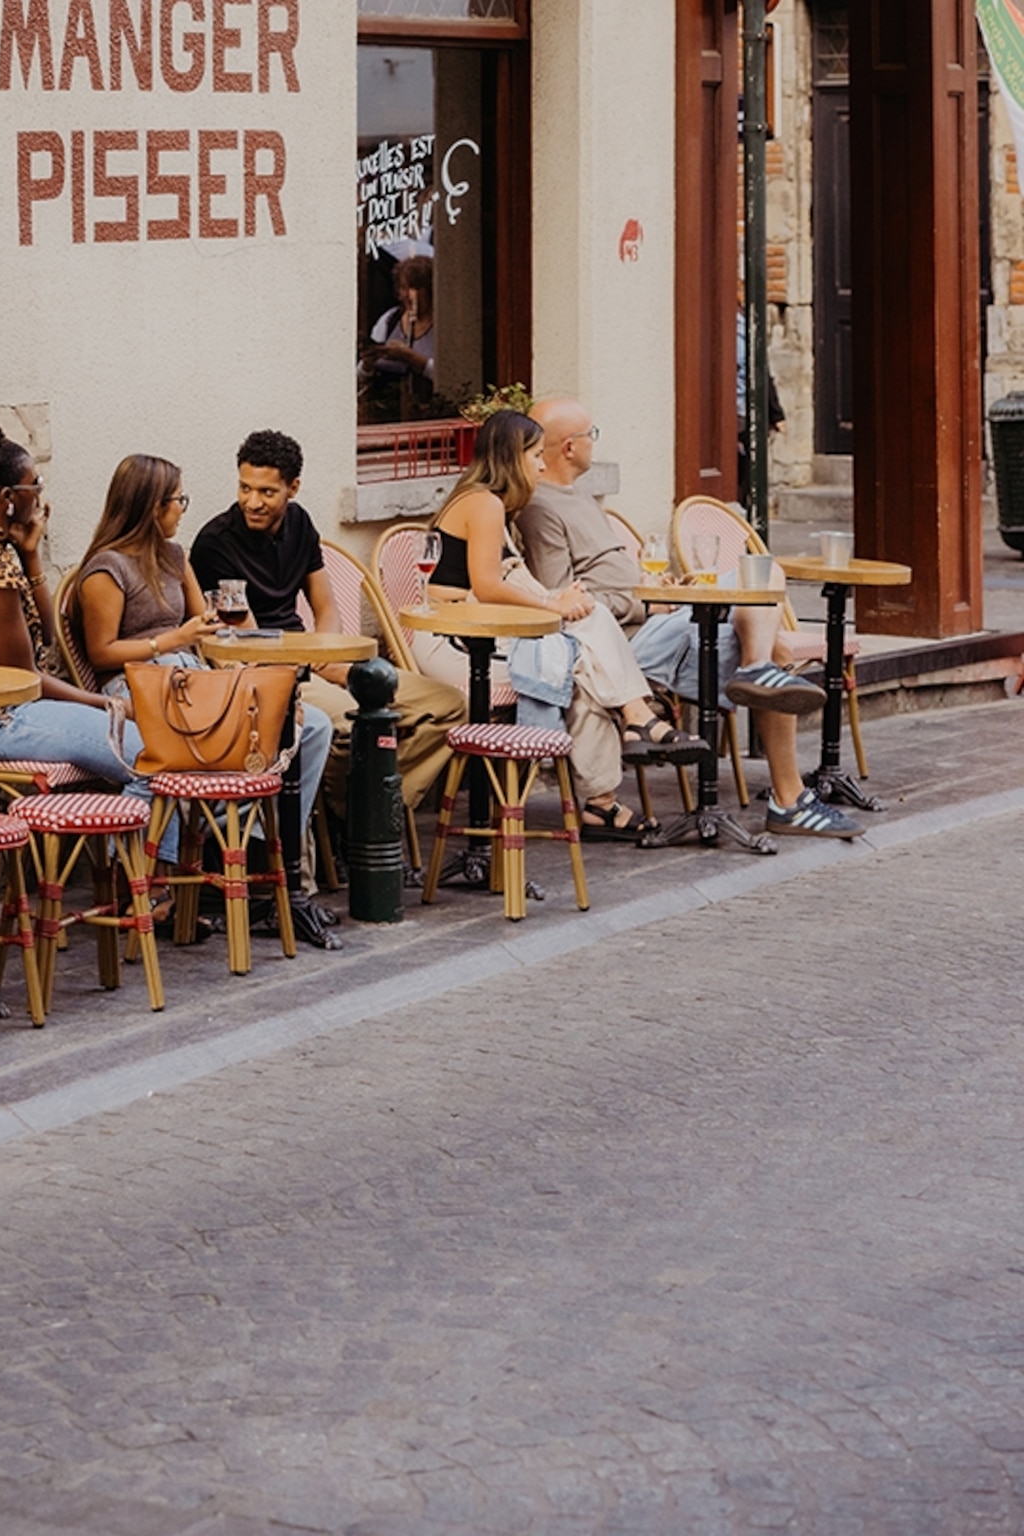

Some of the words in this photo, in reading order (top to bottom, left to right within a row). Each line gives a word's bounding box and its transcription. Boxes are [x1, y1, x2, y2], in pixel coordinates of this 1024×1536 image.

[410, 134, 435, 162] EST
[16, 129, 287, 247] PISSER
[402, 190, 418, 214] LE
[365, 210, 422, 260] RESTER
